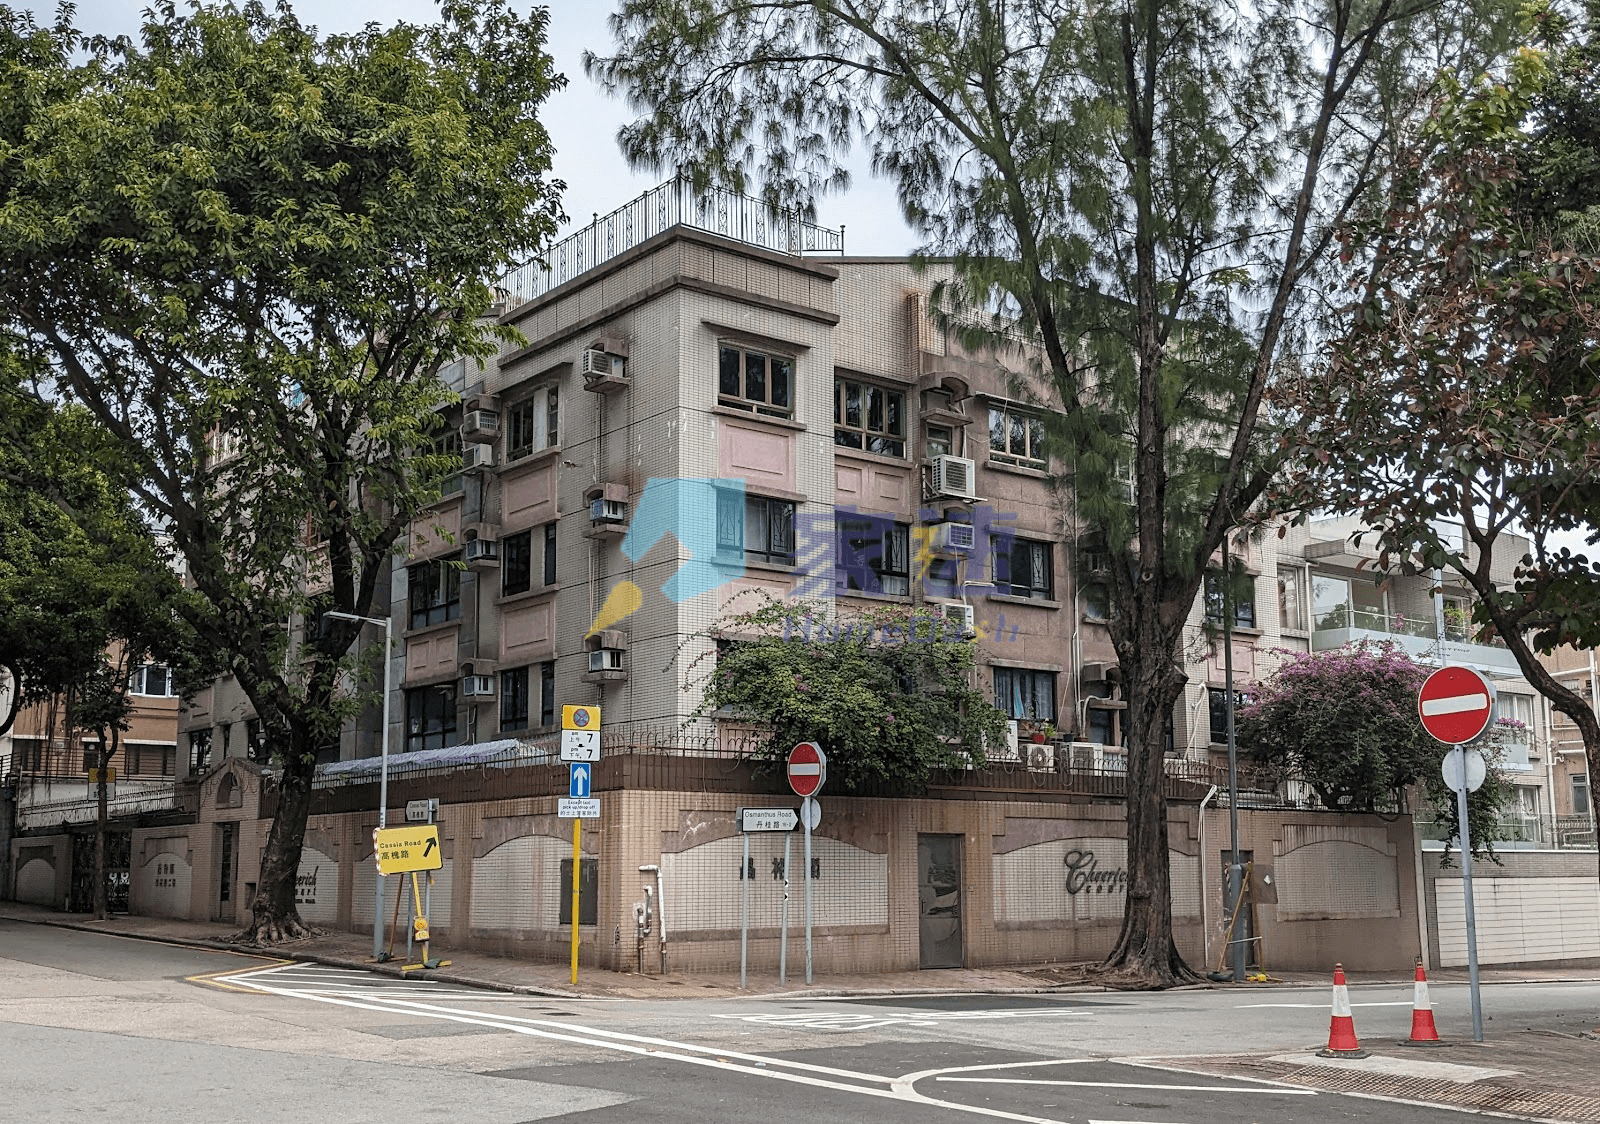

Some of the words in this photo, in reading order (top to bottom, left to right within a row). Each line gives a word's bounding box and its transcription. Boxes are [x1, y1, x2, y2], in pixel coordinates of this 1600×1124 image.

[586, 733, 594, 743] 7
[586, 748, 593, 759] 7
[756, 820, 780, 829] 丹桂路
[404, 839, 422, 847] Road
[1064, 850, 1128, 895] Cheeric
